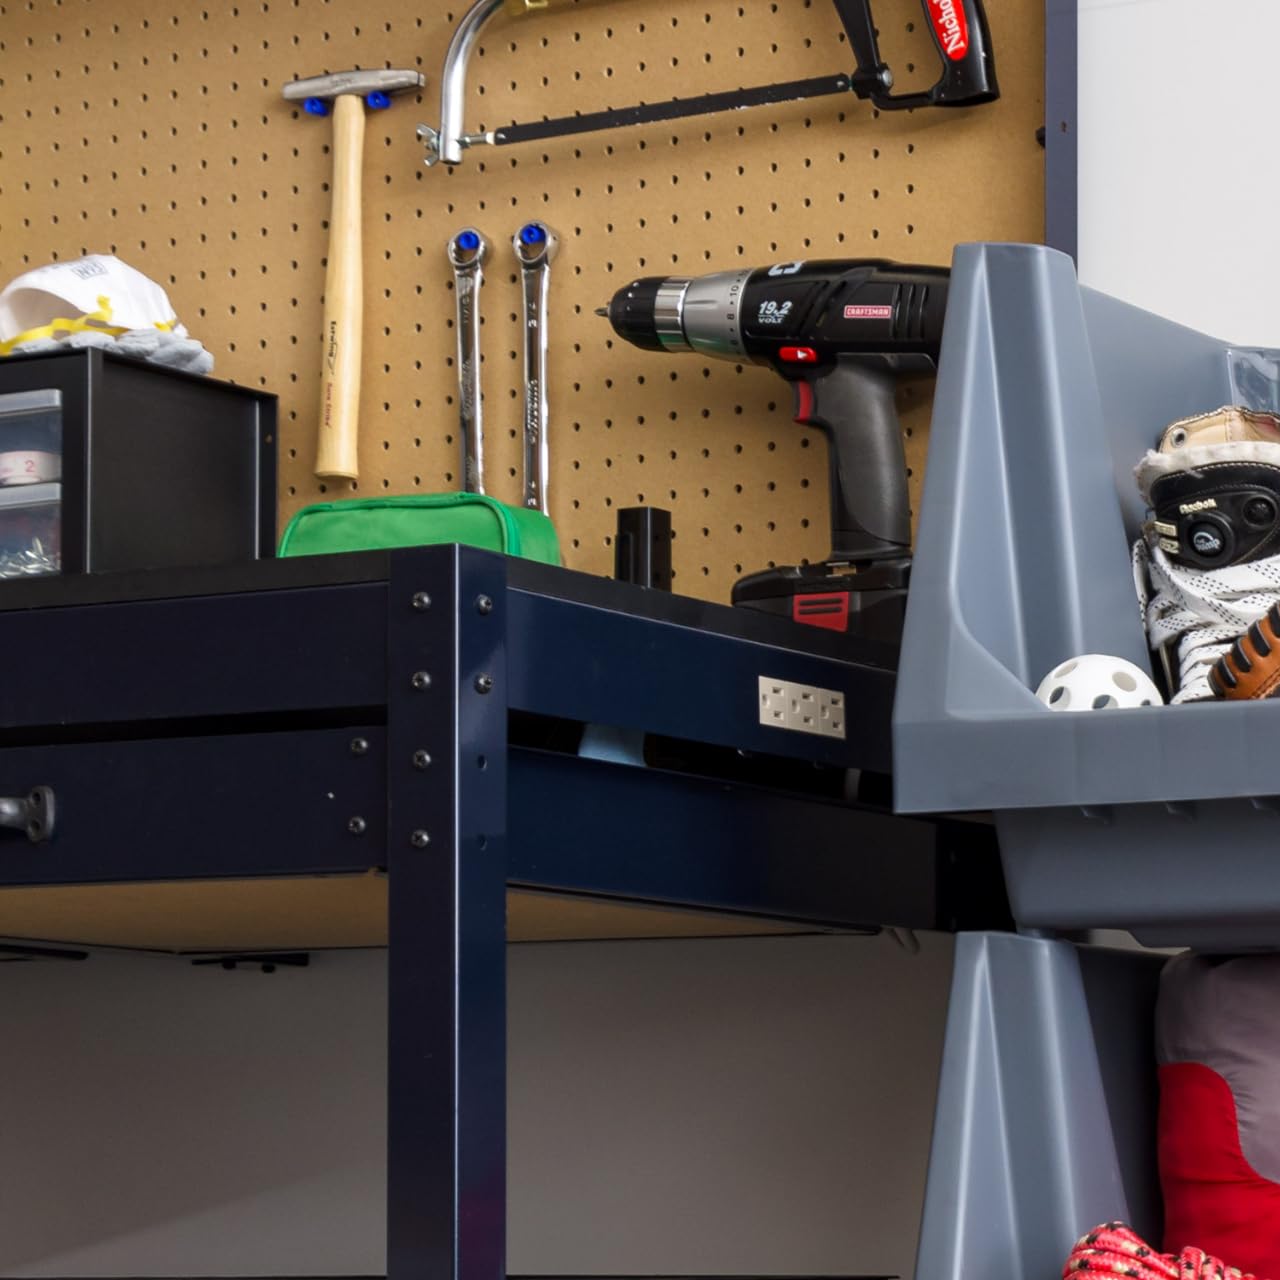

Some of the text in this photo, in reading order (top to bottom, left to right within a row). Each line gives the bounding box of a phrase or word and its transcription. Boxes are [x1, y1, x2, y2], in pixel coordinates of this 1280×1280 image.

[933, 0, 965, 54] Nicho
[758, 300, 793, 315] 19.2
[846, 307, 890, 316] CRAFTSMAN
[758, 316, 783, 324] VOLT
[24, 460, 35, 473] 2
